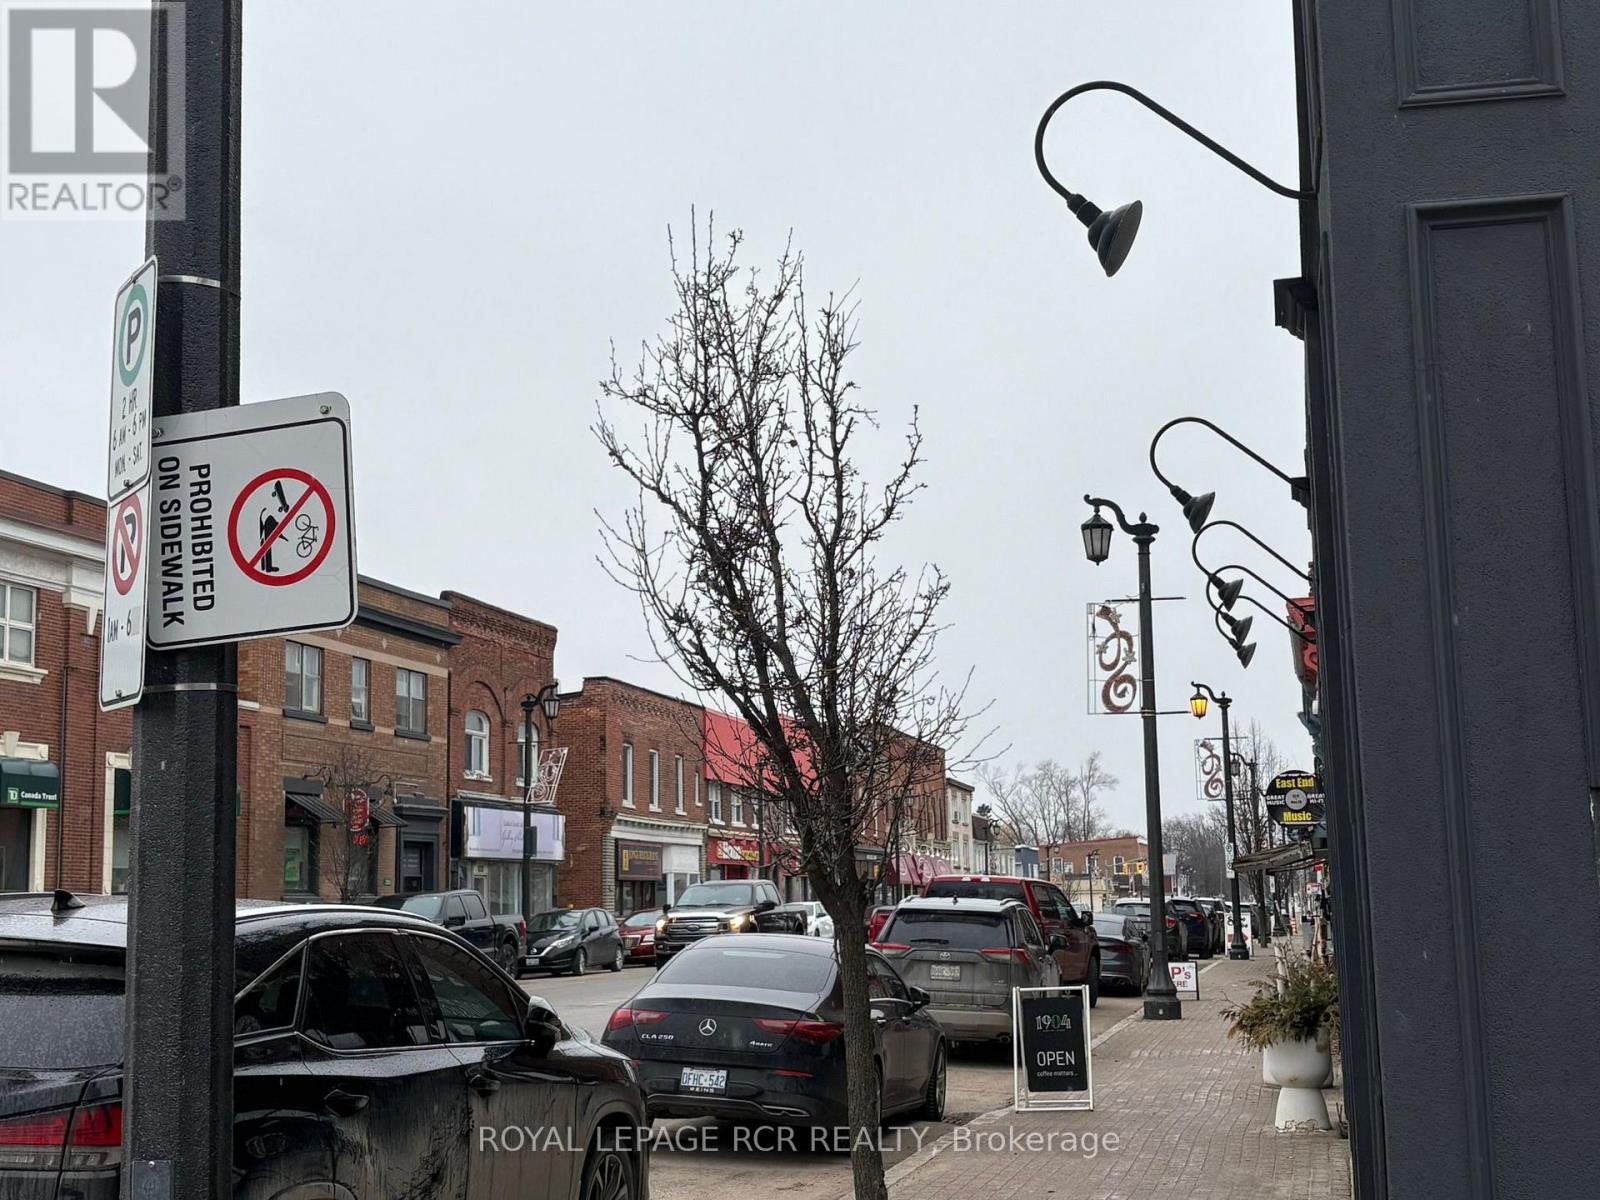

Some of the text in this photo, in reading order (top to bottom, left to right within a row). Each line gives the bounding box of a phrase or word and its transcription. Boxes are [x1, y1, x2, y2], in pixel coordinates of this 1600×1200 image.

[125, 306, 141, 365] P
[129, 388, 138, 415] HR
[119, 424, 127, 447] AM
[133, 412, 137, 436] 6
[139, 407, 147, 431] PM
[114, 453, 127, 478] MON
[133, 441, 143, 466] SAT
[158, 457, 185, 628] ON SIDEWALK
[189, 464, 215, 611] PROHIBITED
[126, 609, 131, 637] 6
[1276, 776, 1315, 788] East End
[21, 791, 41, 799] Canada
[42, 793, 57, 801] Trust
[1283, 811, 1312, 822] Music
[1173, 980, 1189, 988] RE
[1036, 1050, 1075, 1067] OPEN
